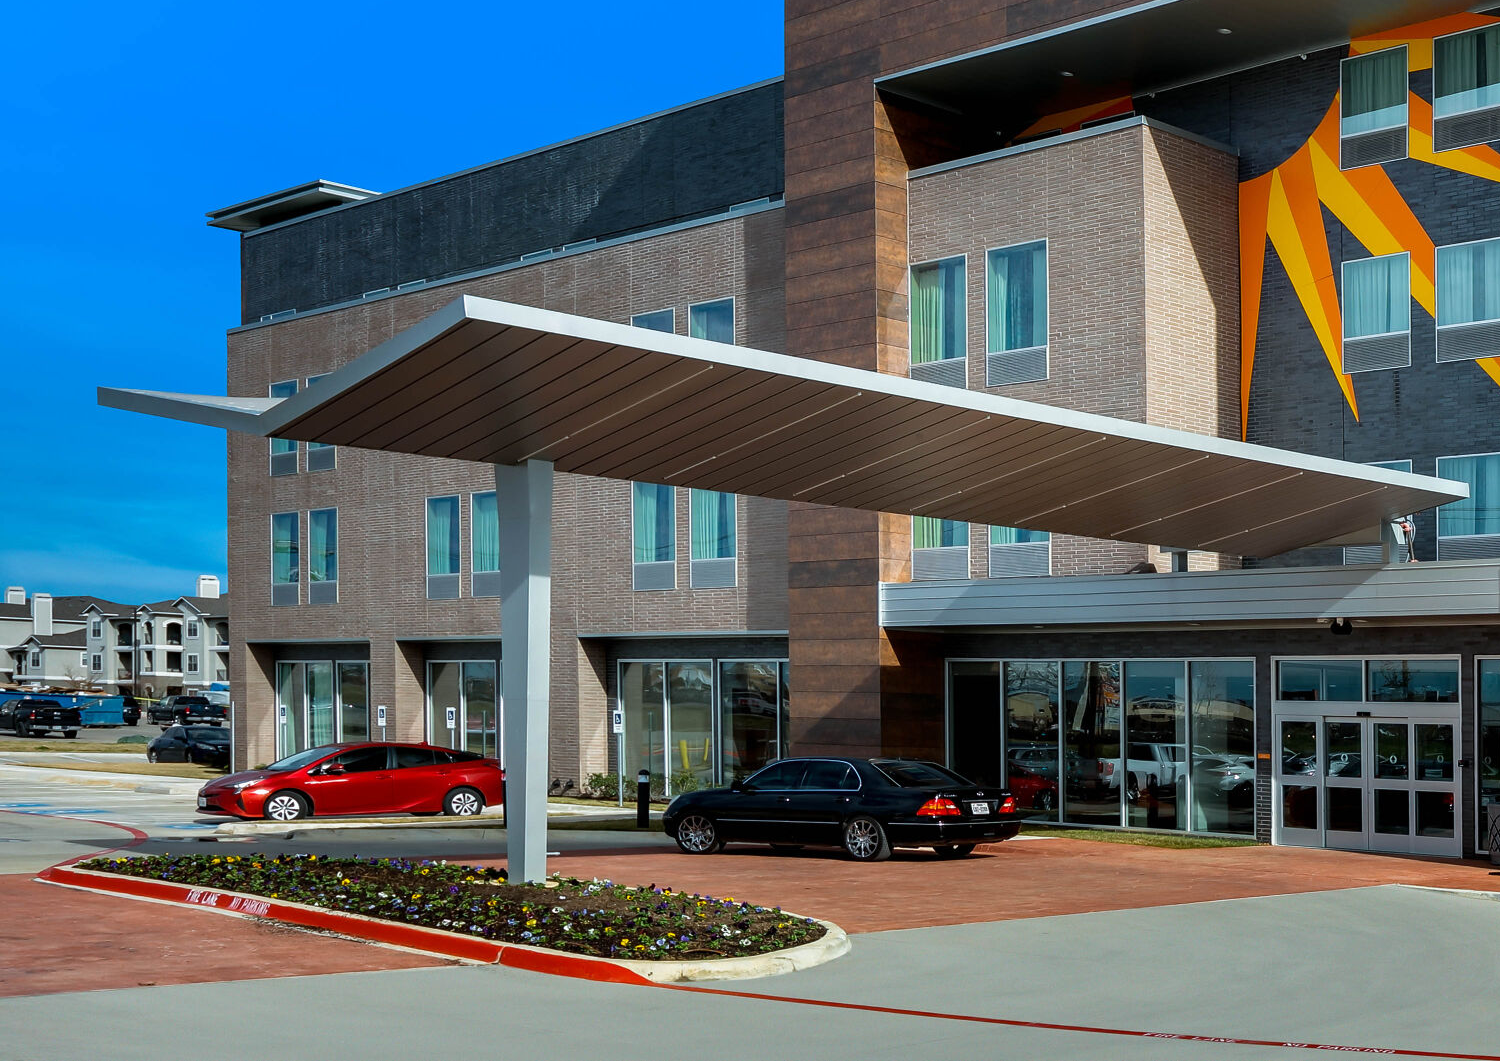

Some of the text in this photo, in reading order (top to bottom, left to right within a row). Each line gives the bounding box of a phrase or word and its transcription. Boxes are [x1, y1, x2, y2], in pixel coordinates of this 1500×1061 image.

[186, 889, 270, 915] FIRE LANE NO PARKING
